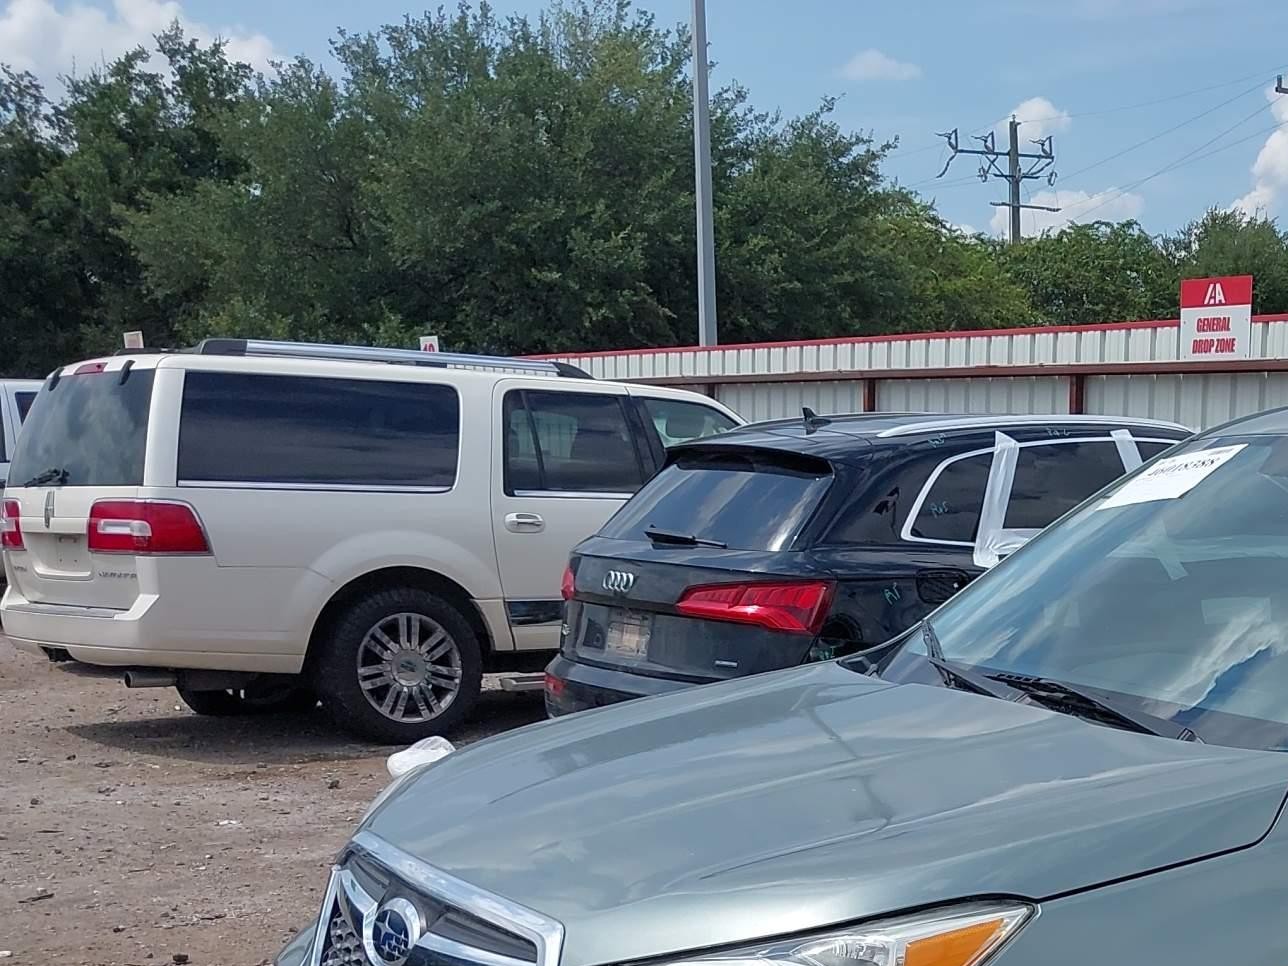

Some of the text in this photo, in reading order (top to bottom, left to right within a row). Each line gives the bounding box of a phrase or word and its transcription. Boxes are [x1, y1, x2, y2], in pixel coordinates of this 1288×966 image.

[1196, 316, 1231, 333] GENERAL
[1191, 337, 1236, 354] DROP ZONE
